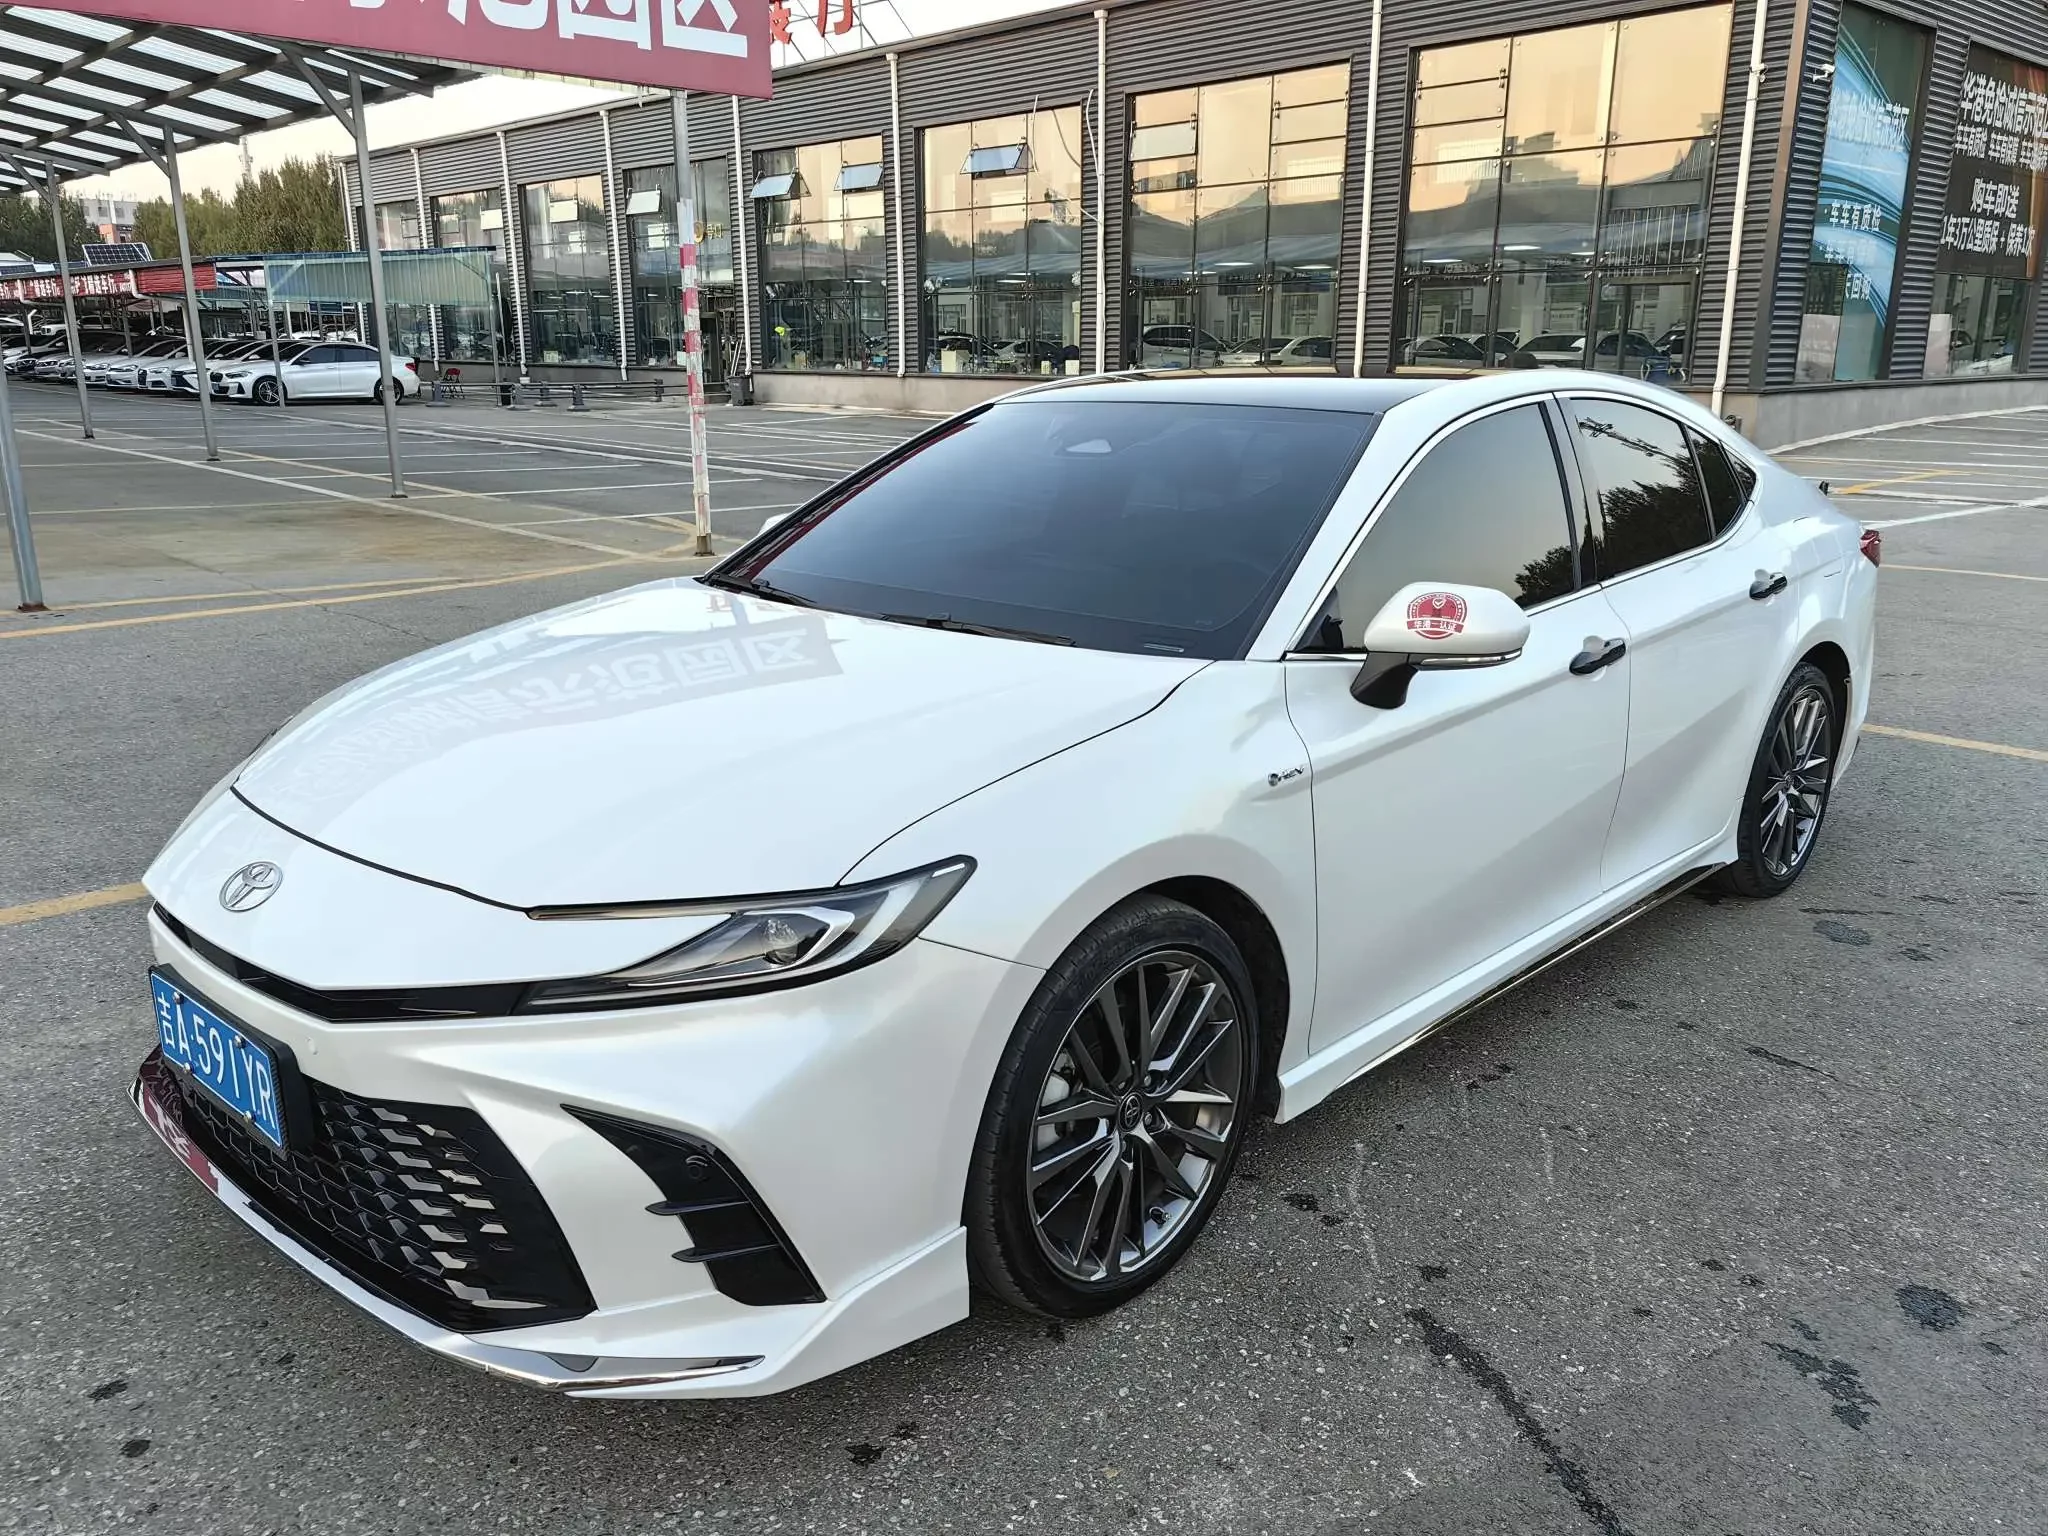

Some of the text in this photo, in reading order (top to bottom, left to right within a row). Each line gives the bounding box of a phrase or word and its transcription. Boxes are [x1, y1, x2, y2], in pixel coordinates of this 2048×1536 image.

[1829, 199, 1882, 231] 车车有质检
[1970, 177, 2020, 219] 购车即送
